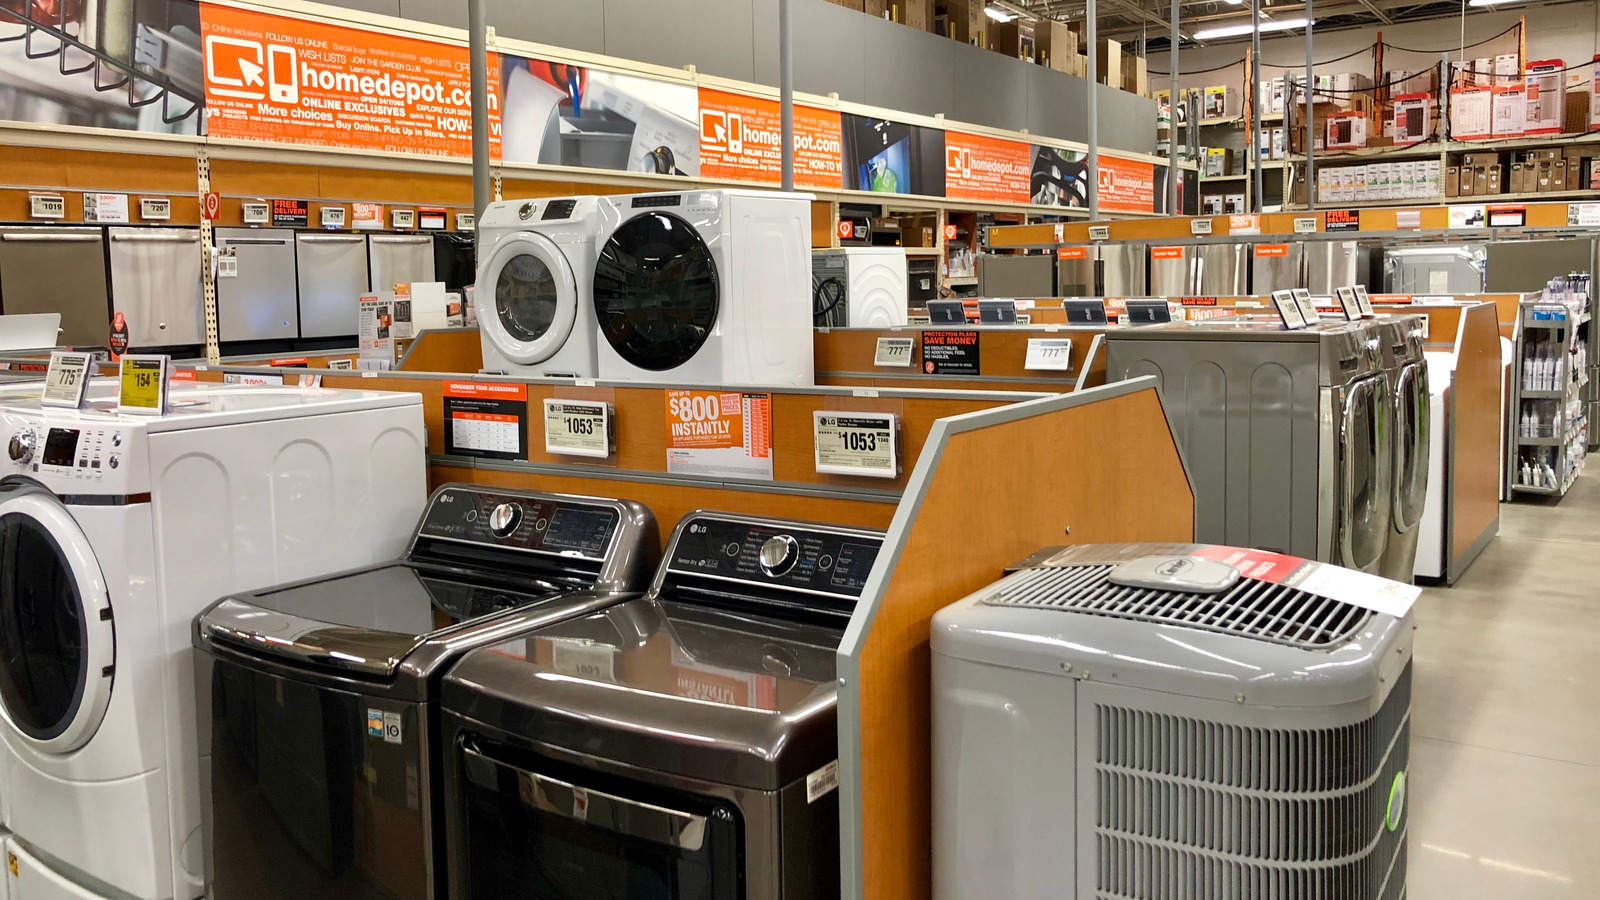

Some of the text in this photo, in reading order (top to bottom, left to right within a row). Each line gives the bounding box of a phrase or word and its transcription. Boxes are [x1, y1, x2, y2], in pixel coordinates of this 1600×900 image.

[266, 32, 293, 43] FOLLOW
[294, 37, 304, 45] US
[305, 38, 328, 48] ONLINE
[420, 56, 434, 65] WISH
[455, 62, 470, 72] OPE
[298, 48, 321, 60] WISH
[324, 52, 346, 64] LISTS
[351, 56, 365, 64] JOIN
[380, 60, 404, 70] GARDEN
[405, 64, 421, 72] CLUB
[350, 66, 365, 74] Learn
[302, 97, 342, 110] ONLINE
[344, 101, 406, 118] EXCLUSIVES
[416, 104, 442, 114] EXPLORE
[360, 96, 378, 104] OPEN
[258, 103, 288, 116] More
[291, 106, 333, 121] choices
[438, 116, 472, 132] HOW-
[336, 120, 351, 130] Buy
[353, 122, 382, 132] Online.
[384, 124, 400, 134] Pick
[402, 127, 412, 136] Up
[424, 129, 446, 138] Store.
[743, 124, 840, 153] homepot.com
[723, 154, 737, 162] More
[738, 156, 758, 164] choices
[809, 159, 835, 171] HOW-TO
[971, 156, 1030, 176] homedepot.com
[1114, 176, 1153, 190] homedepot.com
[274, 200, 298, 208] FREE
[889, 346, 904, 355] 777
[1042, 348, 1060, 358] 777
[670, 395, 719, 422] $800
[564, 417, 592, 434] $1053
[672, 420, 730, 436] INSTANTLY
[838, 432, 876, 451] $1053
[386, 724, 399, 737] 10
